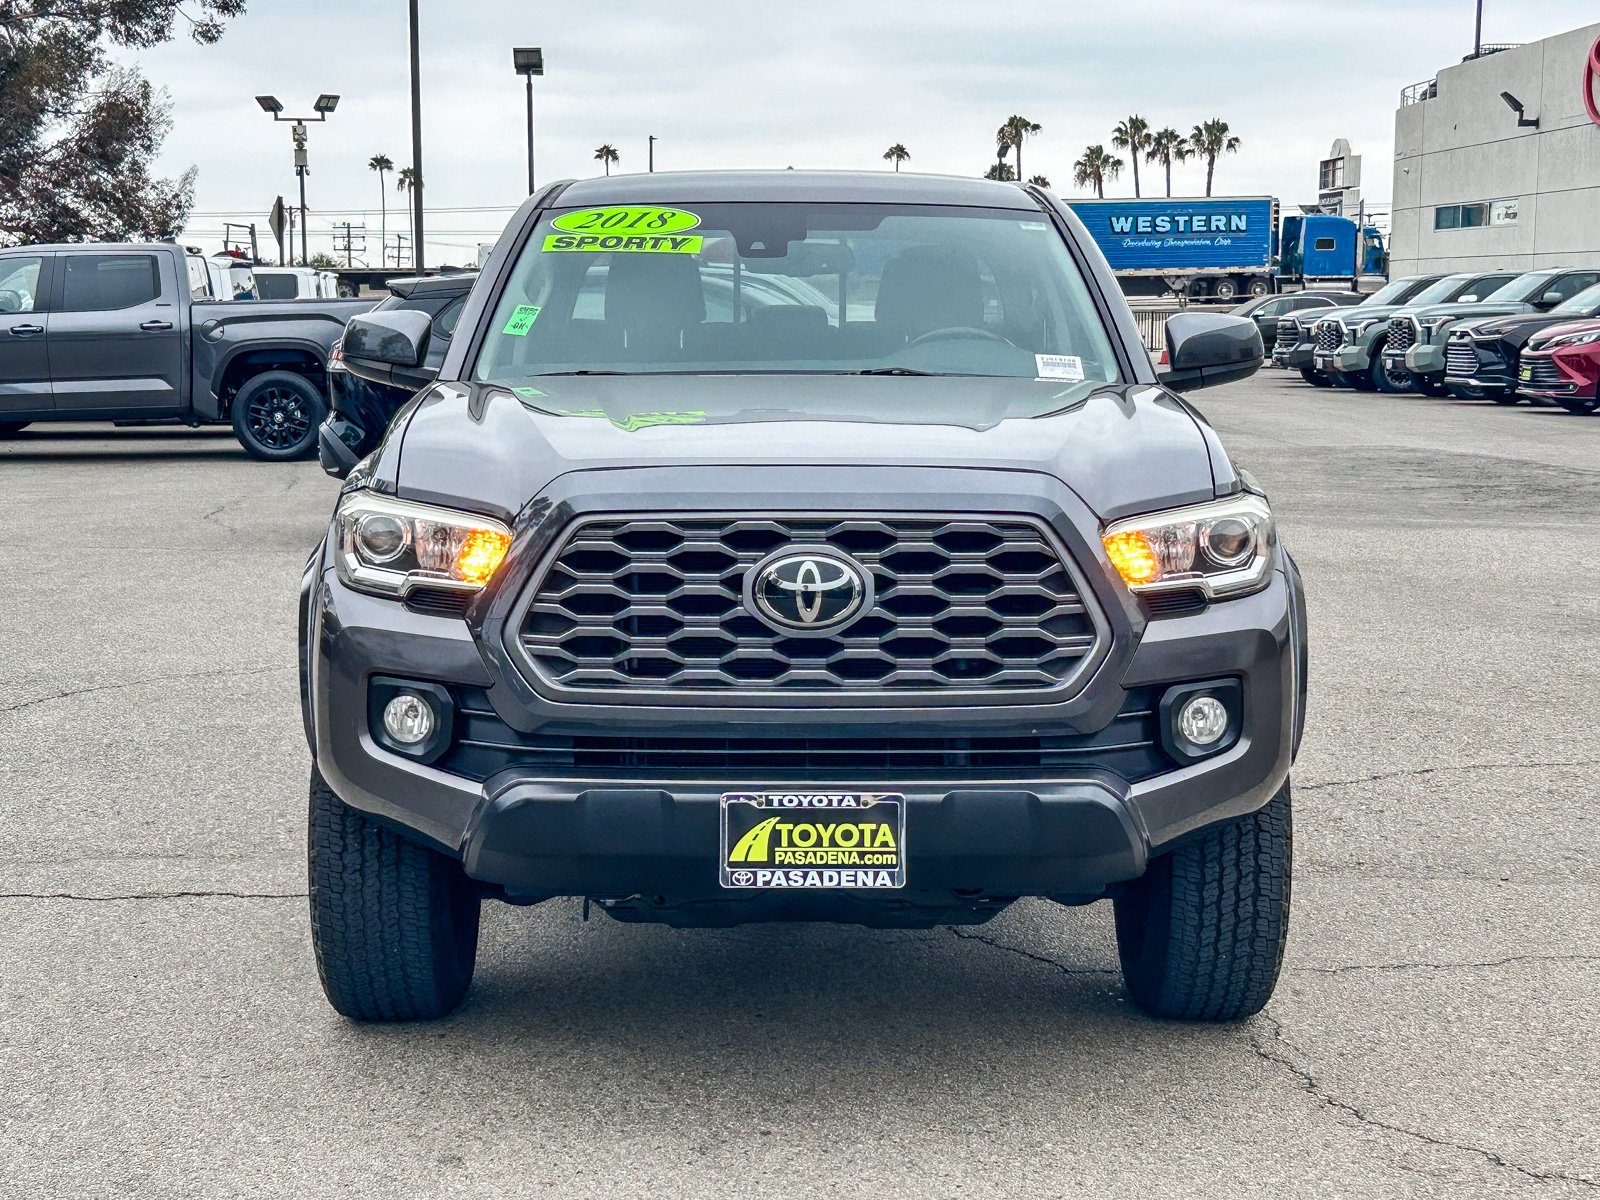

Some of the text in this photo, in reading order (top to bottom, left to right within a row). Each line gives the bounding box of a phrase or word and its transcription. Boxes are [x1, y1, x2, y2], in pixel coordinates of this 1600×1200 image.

[573, 211, 677, 230] 2018
[1110, 214, 1247, 234] WESTERN
[552, 235, 694, 251] SPORTY
[768, 795, 857, 807] TOYOTA
[775, 823, 897, 848] TOYOTA
[774, 851, 897, 865] PASADENA.com
[756, 870, 893, 887] PASADENA
